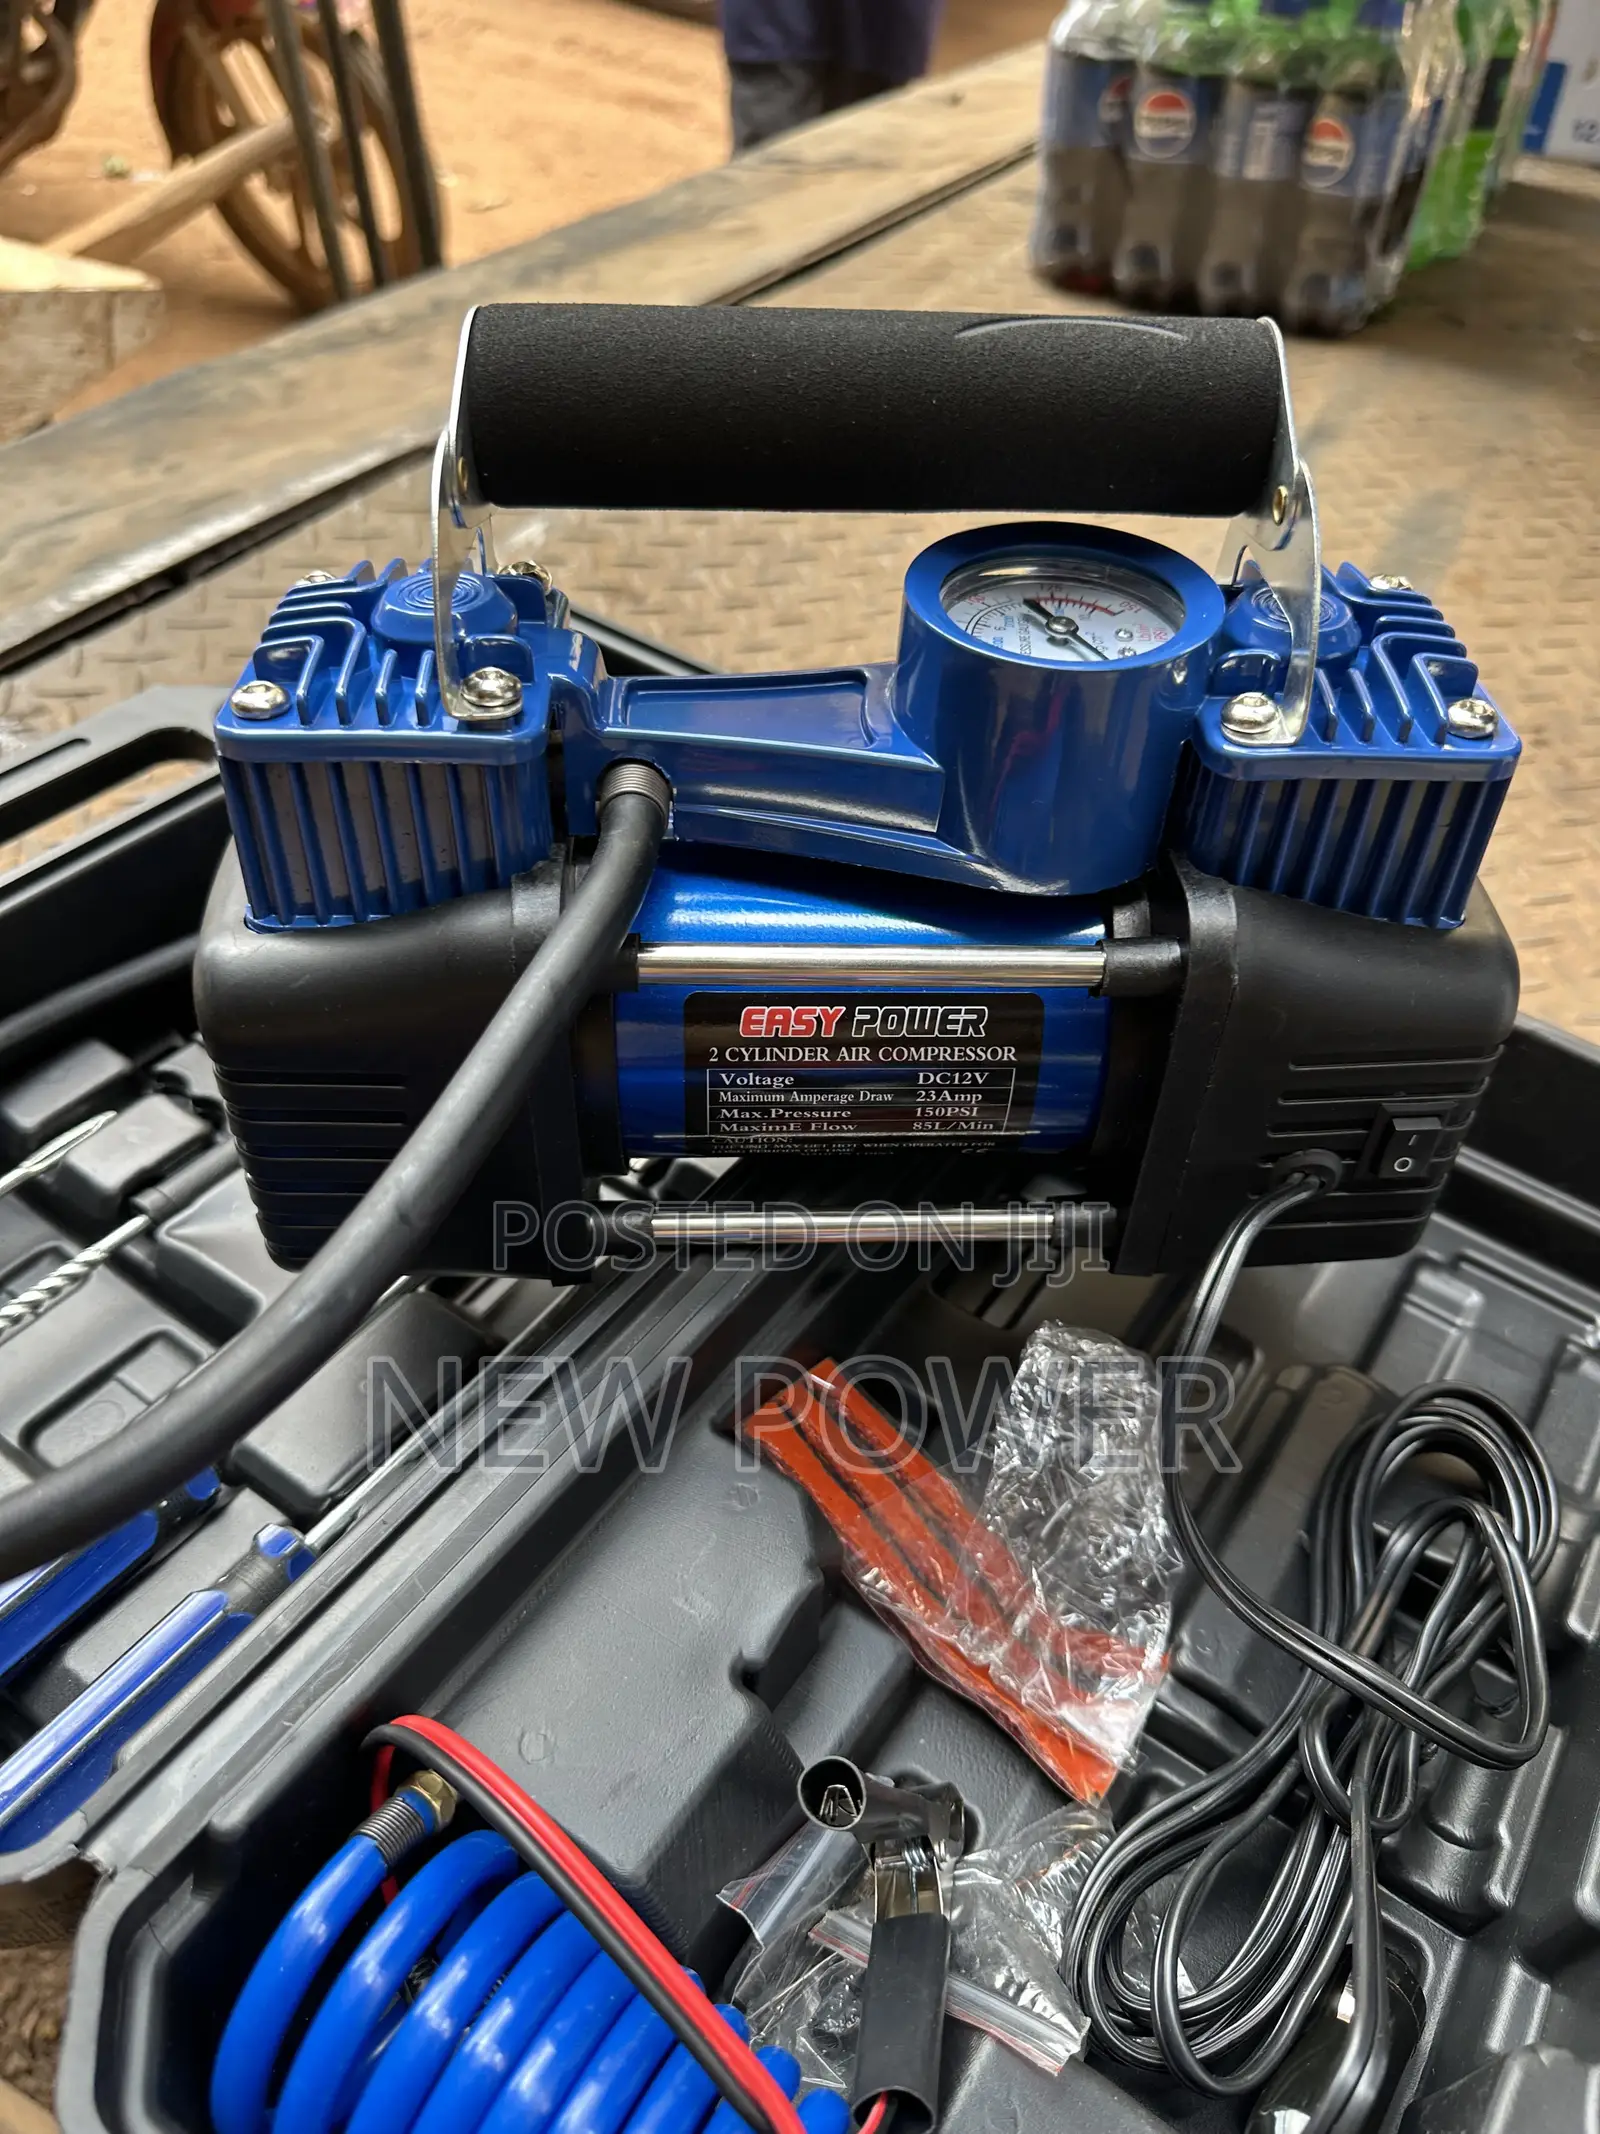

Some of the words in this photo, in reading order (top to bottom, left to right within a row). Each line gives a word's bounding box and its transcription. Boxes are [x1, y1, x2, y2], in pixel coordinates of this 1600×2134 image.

[739, 1006, 846, 1038] EASY
[851, 1006, 989, 1038] POWER
[709, 1048, 719, 1063] 2
[725, 1047, 829, 1063] CYLINDER
[836, 1047, 871, 1062] AIR
[878, 1046, 1018, 1062] COMPRESSOR
[719, 1073, 795, 1090] Voltage
[917, 1072, 990, 1086] DC12V
[719, 1091, 785, 1103] Maximum
[789, 1091, 855, 1106] Amperage
[859, 1091, 895, 1102] Draw
[916, 1091, 983, 1105] 23Amp
[719, 1108, 852, 1119] Max.Pressure
[915, 1106, 979, 1118] 150PSI
[720, 1123, 802, 1132] MaximE
[810, 1122, 858, 1132] Flow
[912, 1121, 994, 1131] 85L/Min
